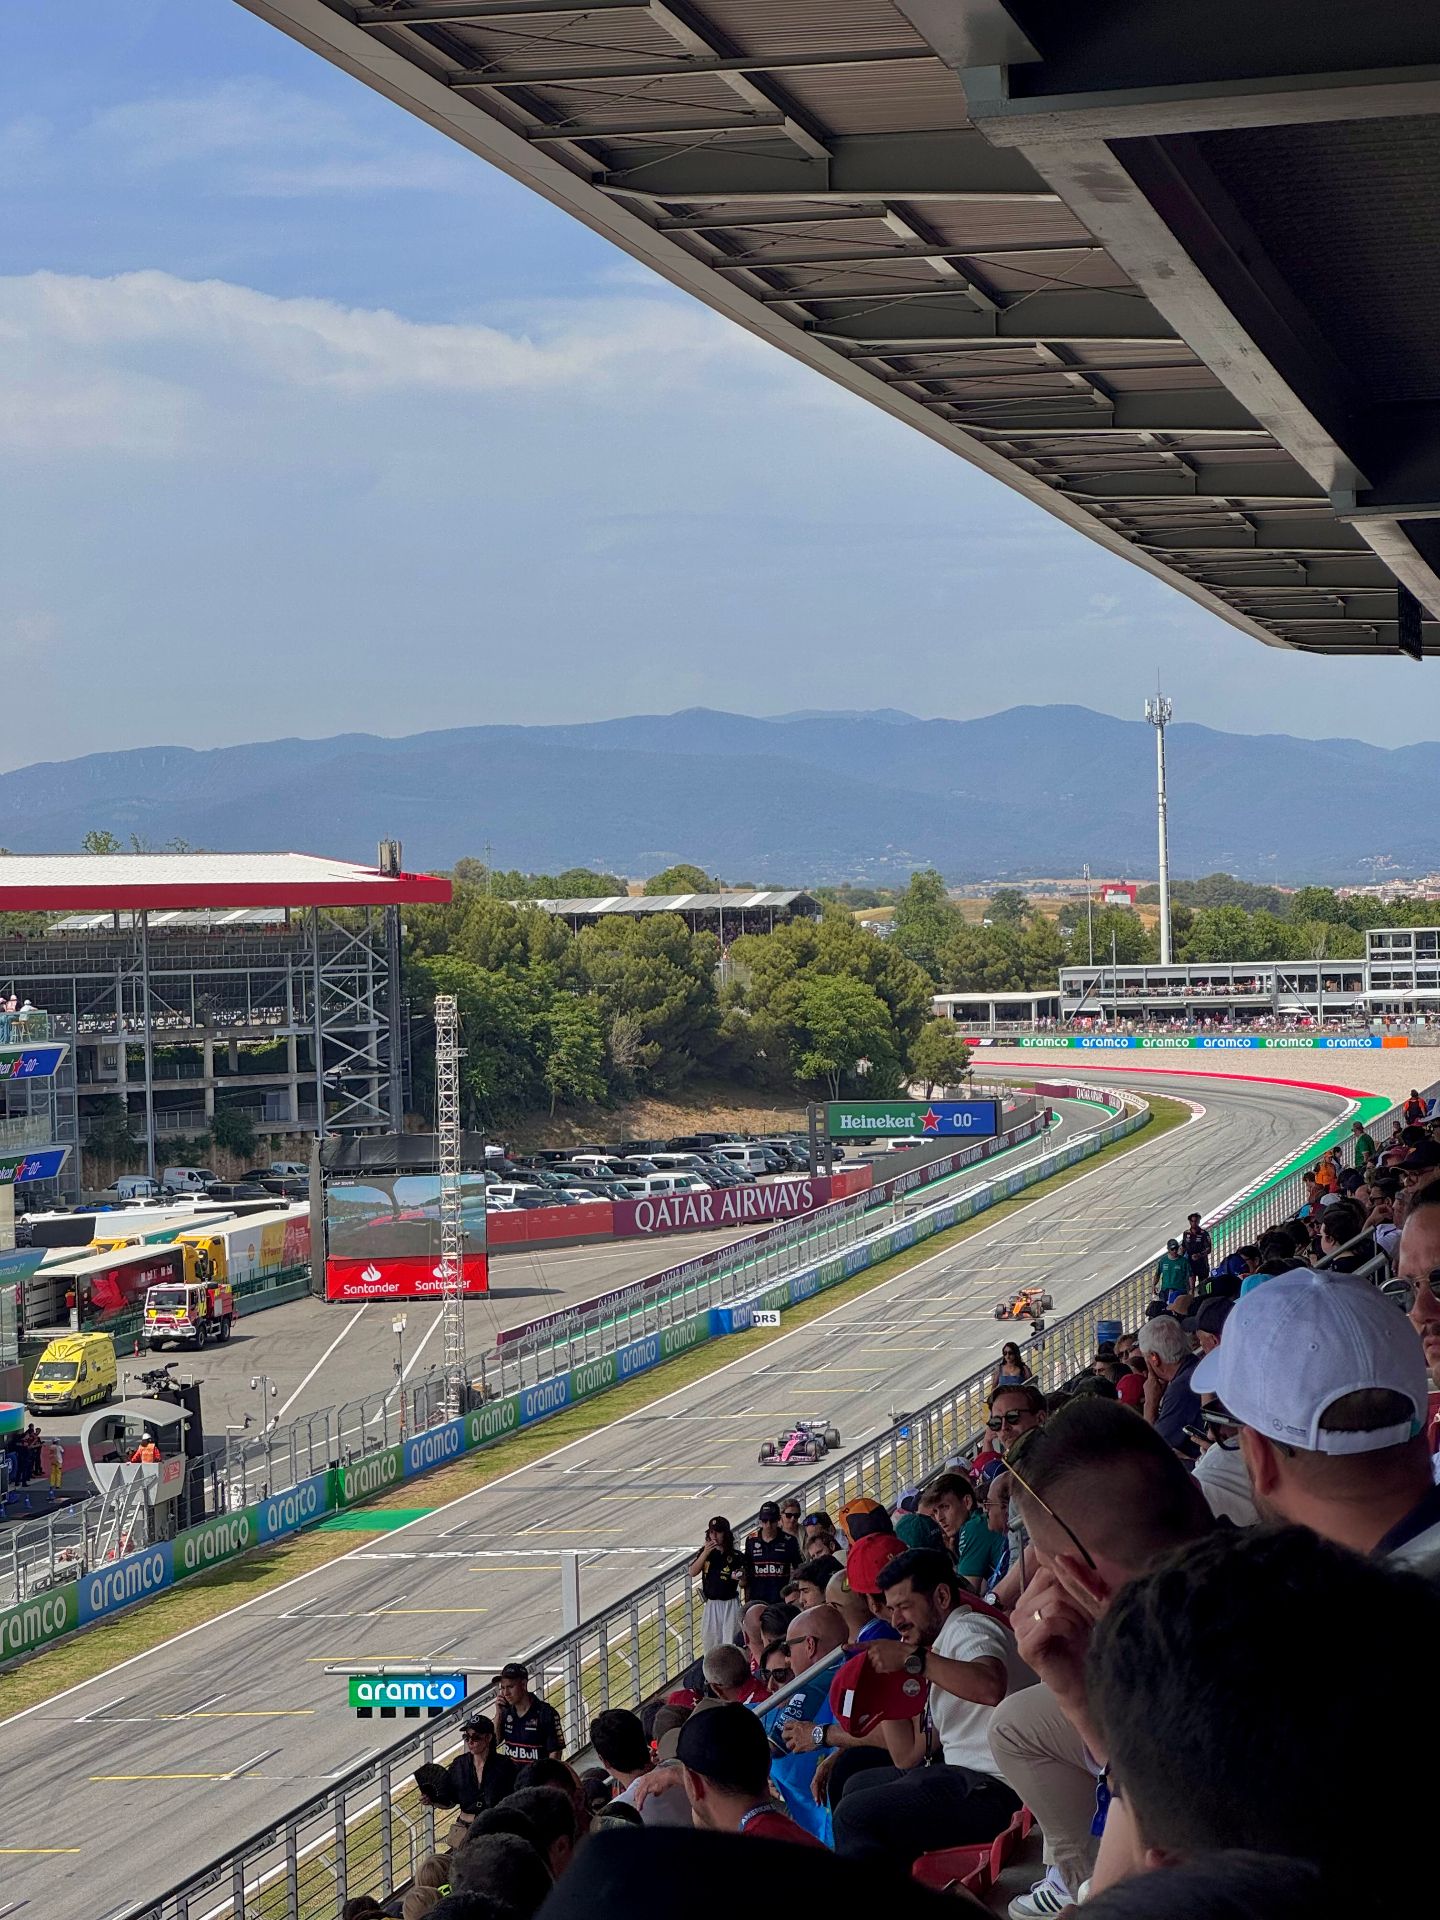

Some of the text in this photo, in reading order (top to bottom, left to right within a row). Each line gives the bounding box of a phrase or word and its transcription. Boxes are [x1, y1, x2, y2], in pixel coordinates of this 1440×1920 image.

[1022, 1037, 1069, 1047] aramco
[1082, 1038, 1128, 1047] aramco
[1143, 1038, 1189, 1047] aramco
[1203, 1038, 1250, 1047] aramco
[1266, 1038, 1313, 1047] aramco
[1327, 1038, 1372, 1047] aramco
[840, 1114, 915, 1129] Heineken
[635, 1194, 713, 1231] QATAR
[720, 1181, 813, 1220] AIRWAYS
[821, 1261, 842, 1284] aramco
[343, 1283, 400, 1295] Santander
[793, 1273, 816, 1298] aramco
[764, 1287, 789, 1310] aramco
[753, 1314, 777, 1324] DRS
[664, 1323, 697, 1353] aramco
[622, 1340, 656, 1373] aramco
[576, 1359, 613, 1393] aramco
[526, 1380, 566, 1416] aramco
[471, 1402, 515, 1442] aramco
[411, 1427, 459, 1469] aramco
[344, 1453, 397, 1499] aramco
[184, 1516, 249, 1568] aramco
[90, 1553, 164, 1611] aramco
[357, 1683, 456, 1700] aramco
[504, 1744, 539, 1760] Red Bull
